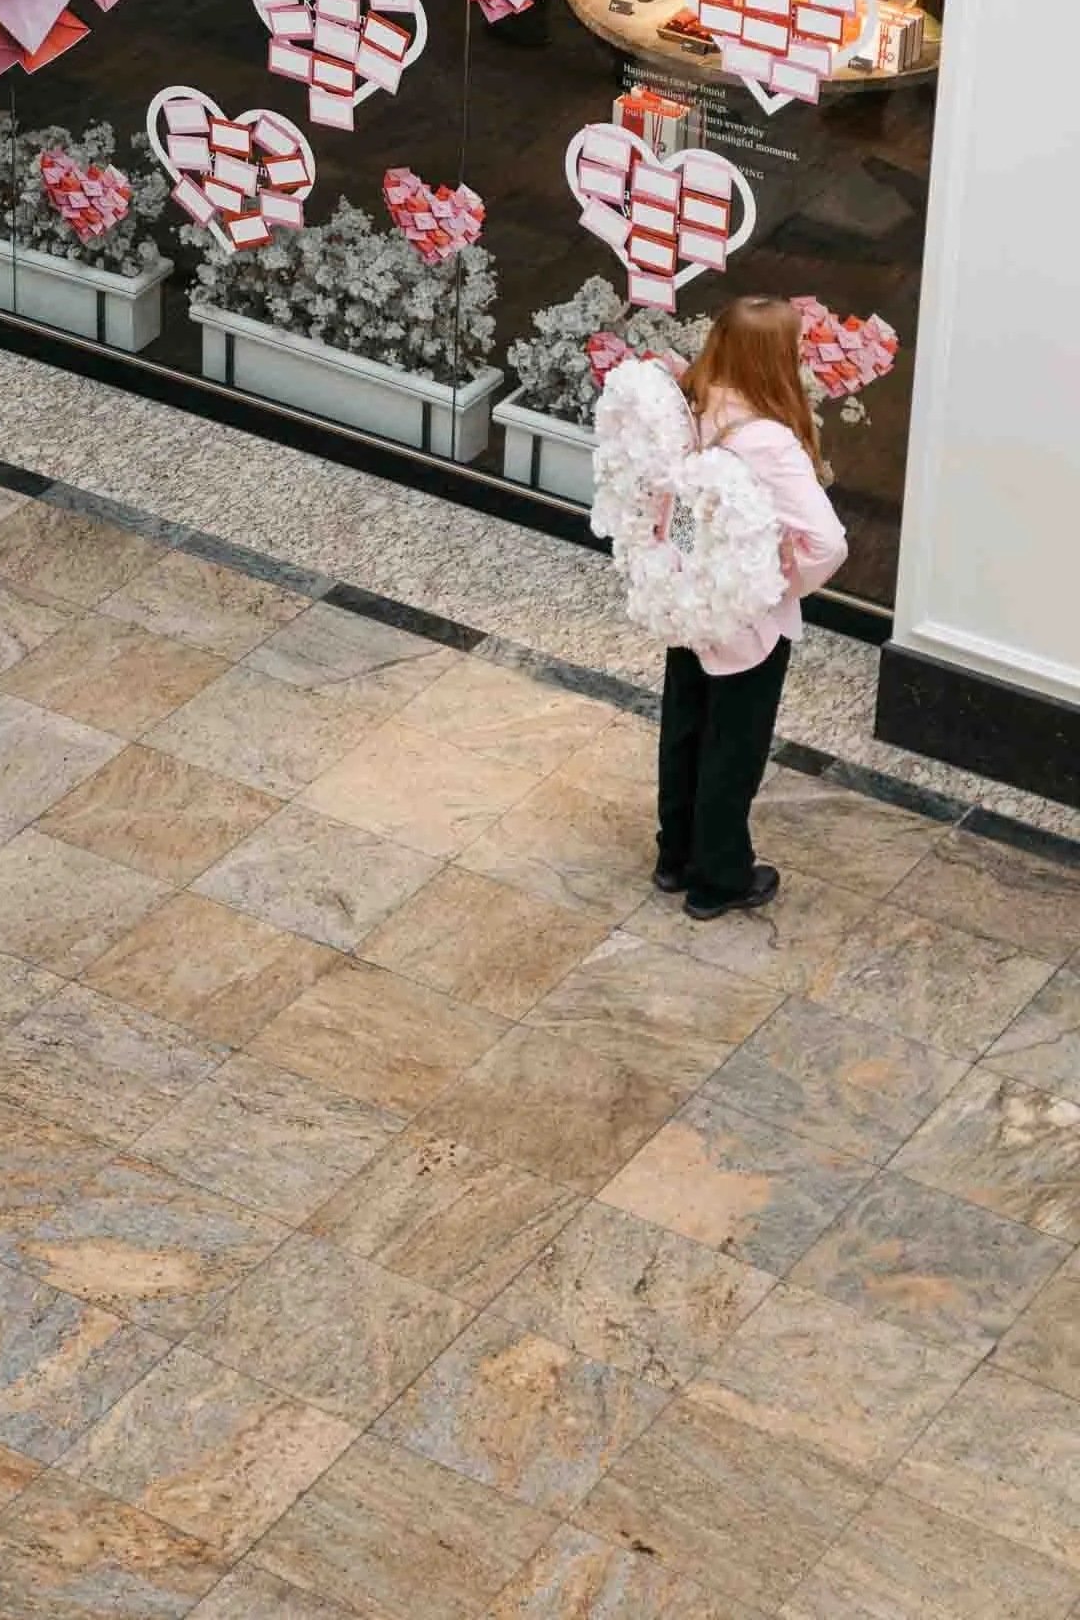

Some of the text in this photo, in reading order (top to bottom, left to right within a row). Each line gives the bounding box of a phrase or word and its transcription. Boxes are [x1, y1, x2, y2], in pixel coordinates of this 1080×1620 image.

[623, 63, 670, 83] Happiness
[699, 83, 727, 99] found
[704, 130, 801, 162] meaningful moments.
[724, 122, 764, 139] everyday
